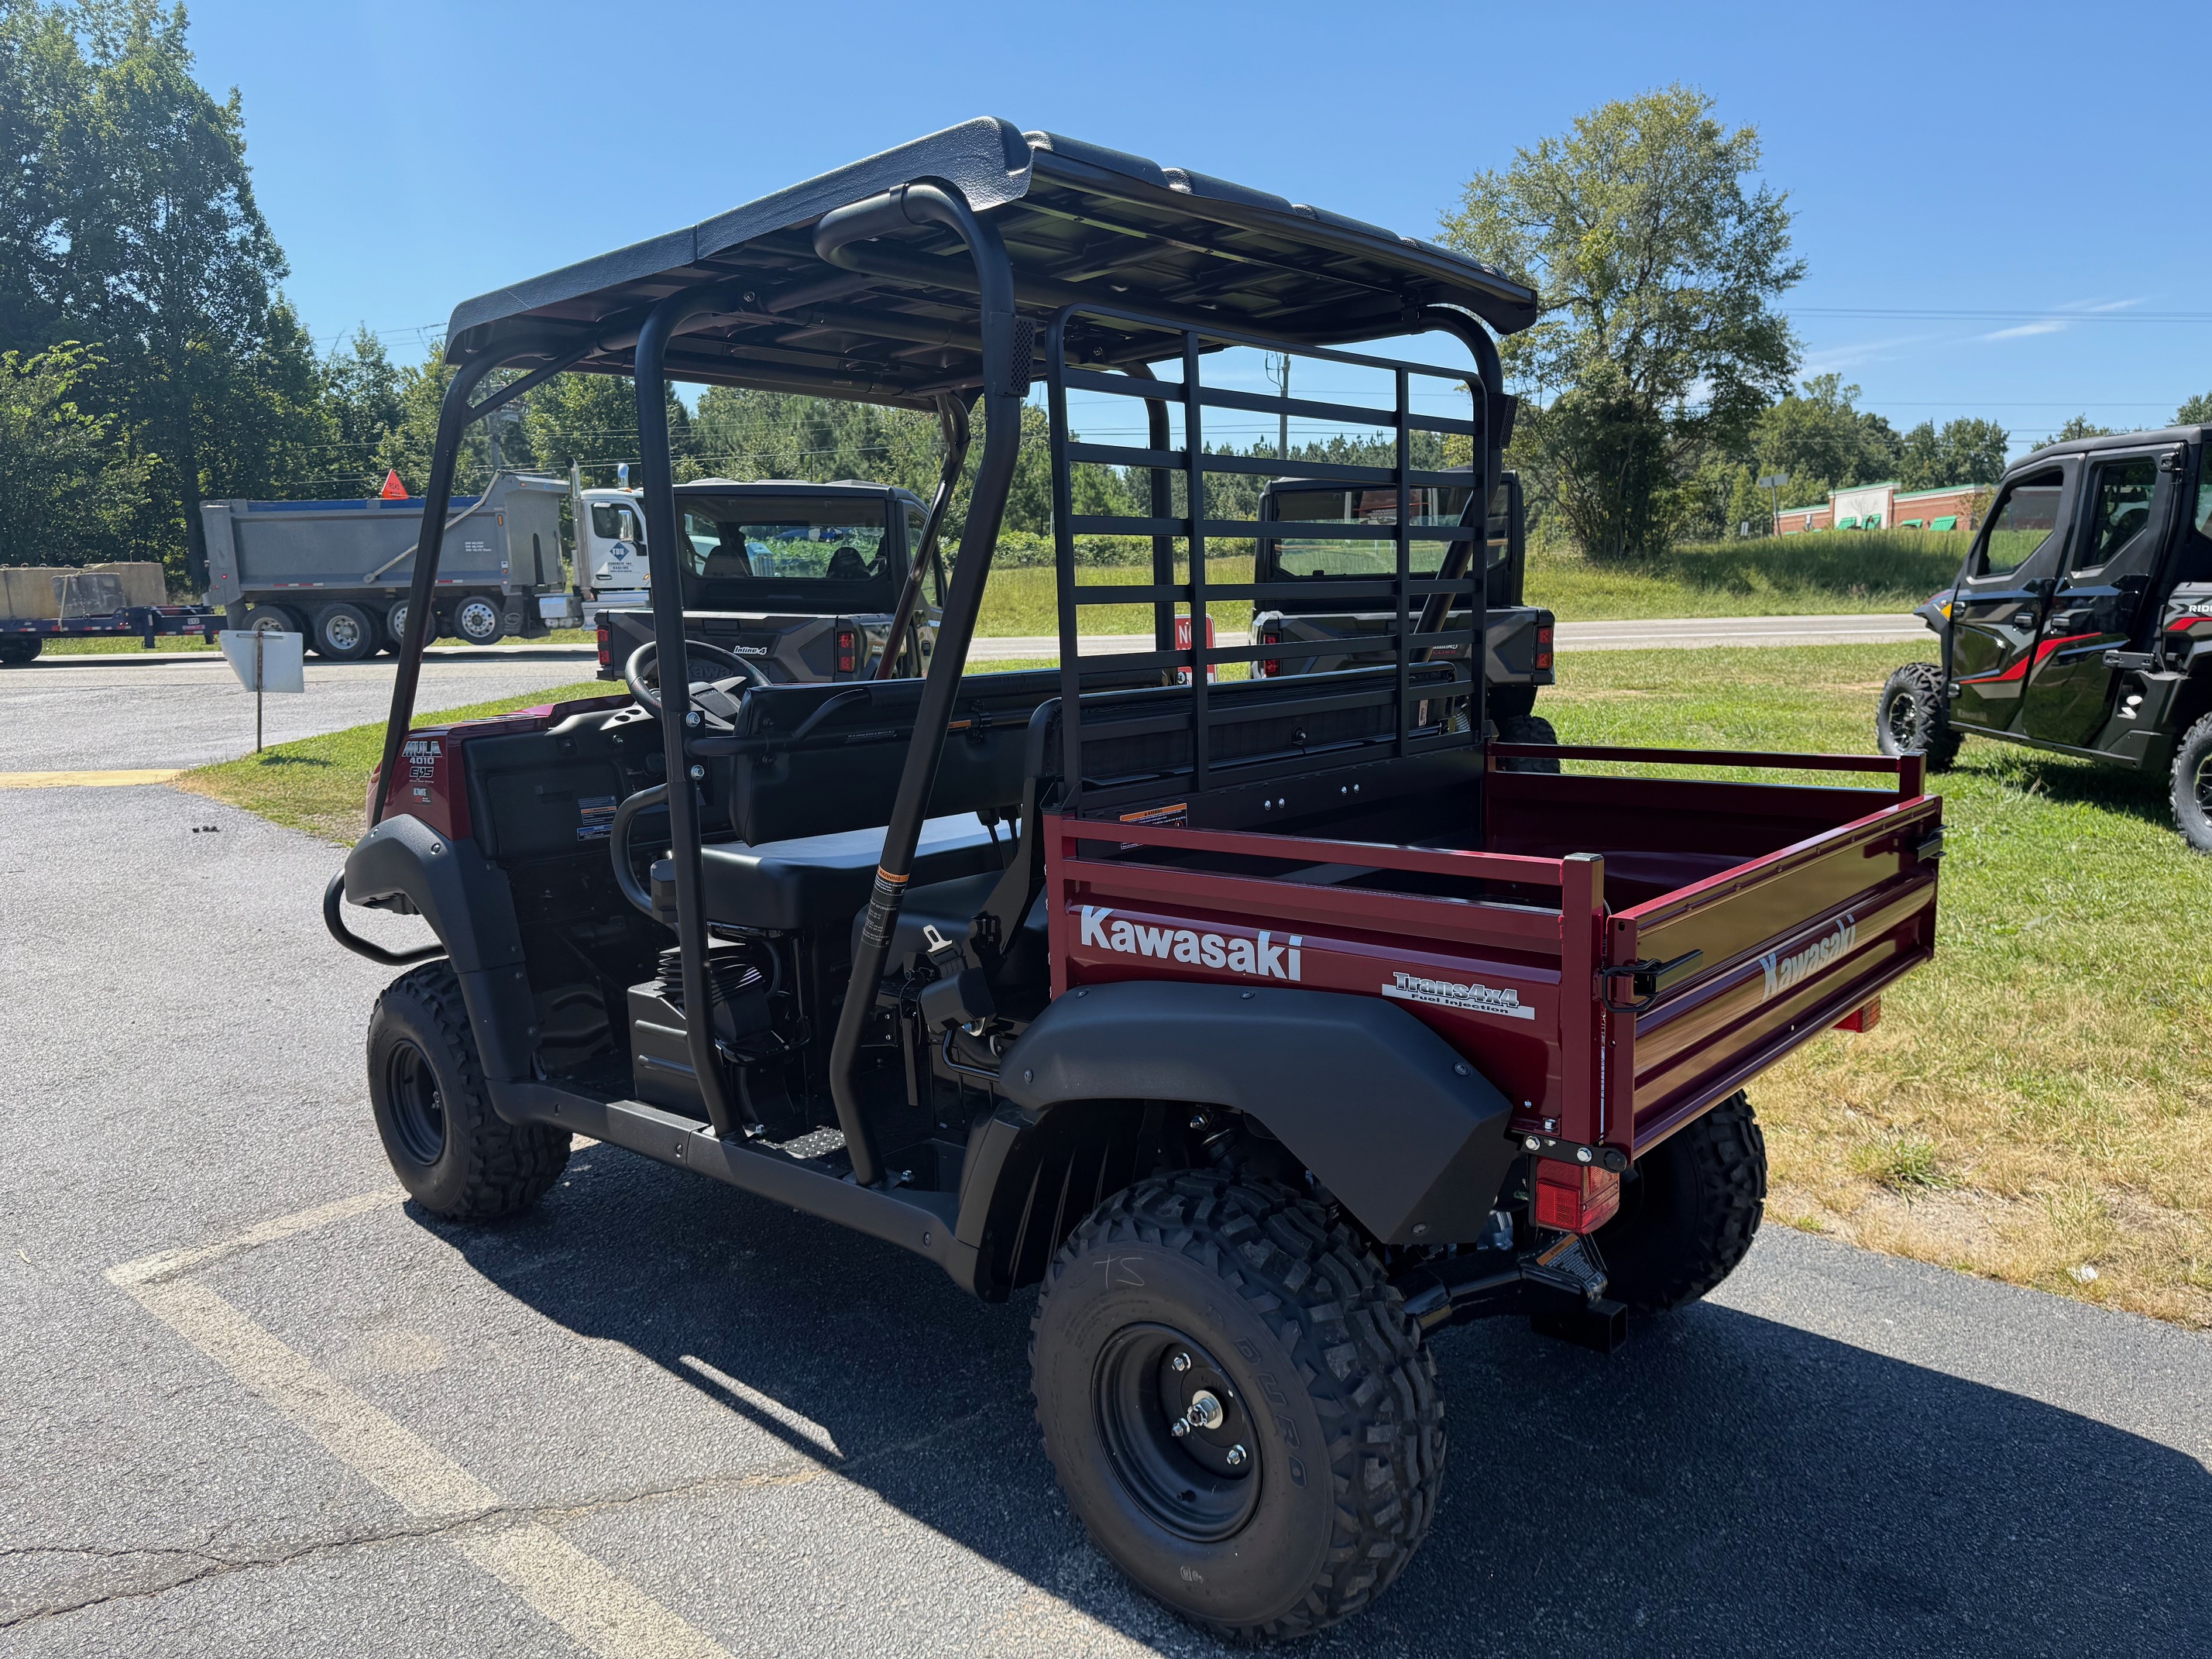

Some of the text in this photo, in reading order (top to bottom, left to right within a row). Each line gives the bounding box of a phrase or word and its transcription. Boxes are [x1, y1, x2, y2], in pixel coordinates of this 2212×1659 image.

[1179, 625, 1192, 644] N
[402, 740, 442, 757] MULE
[878, 870, 902, 881] WARNING
[1081, 905, 1304, 982] Kawasaki
[1759, 913, 1856, 1003] Kawasaki
[1393, 971, 1520, 1008] Trans4x4
[1411, 994, 1510, 1014] Fuel Injection
[1233, 1337, 1308, 1489] DURO
